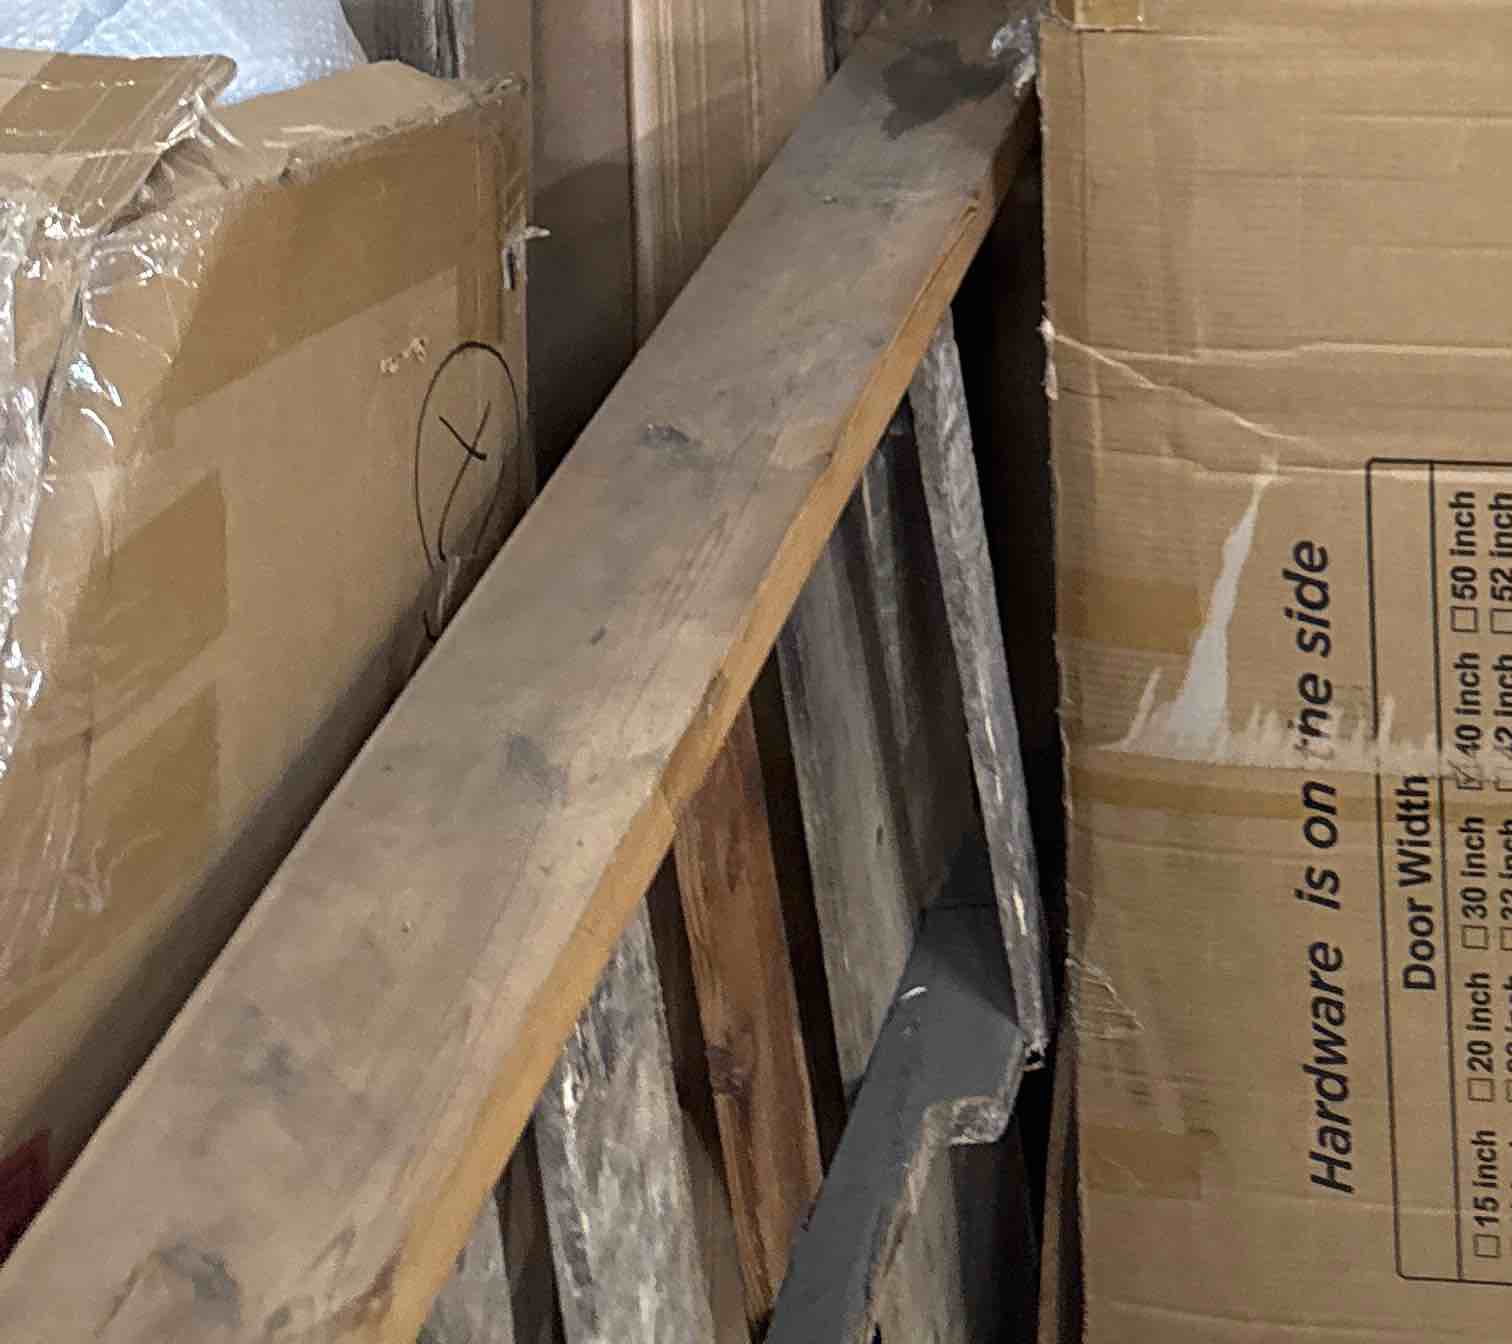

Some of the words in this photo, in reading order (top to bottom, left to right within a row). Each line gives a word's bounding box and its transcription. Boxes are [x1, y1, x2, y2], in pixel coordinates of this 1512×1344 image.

[1447, 490, 1477, 557] inch
[1281, 540, 1332, 659] side
[1449, 565, 1478, 601] 50
[1452, 652, 1482, 716] inch
[1454, 722, 1485, 760] 40
[1301, 780, 1339, 850] on
[1394, 775, 1436, 888] Width
[1458, 816, 1488, 878] inch
[1294, 865, 1342, 911] is
[1459, 886, 1489, 920] 30
[1402, 895, 1437, 991] Door
[1463, 972, 1493, 1032] inch
[1301, 941, 1355, 1194] Hardware
[1466, 1039, 1494, 1074] 20
[1470, 1129, 1499, 1190] inch
[1472, 1196, 1500, 1228] 15
